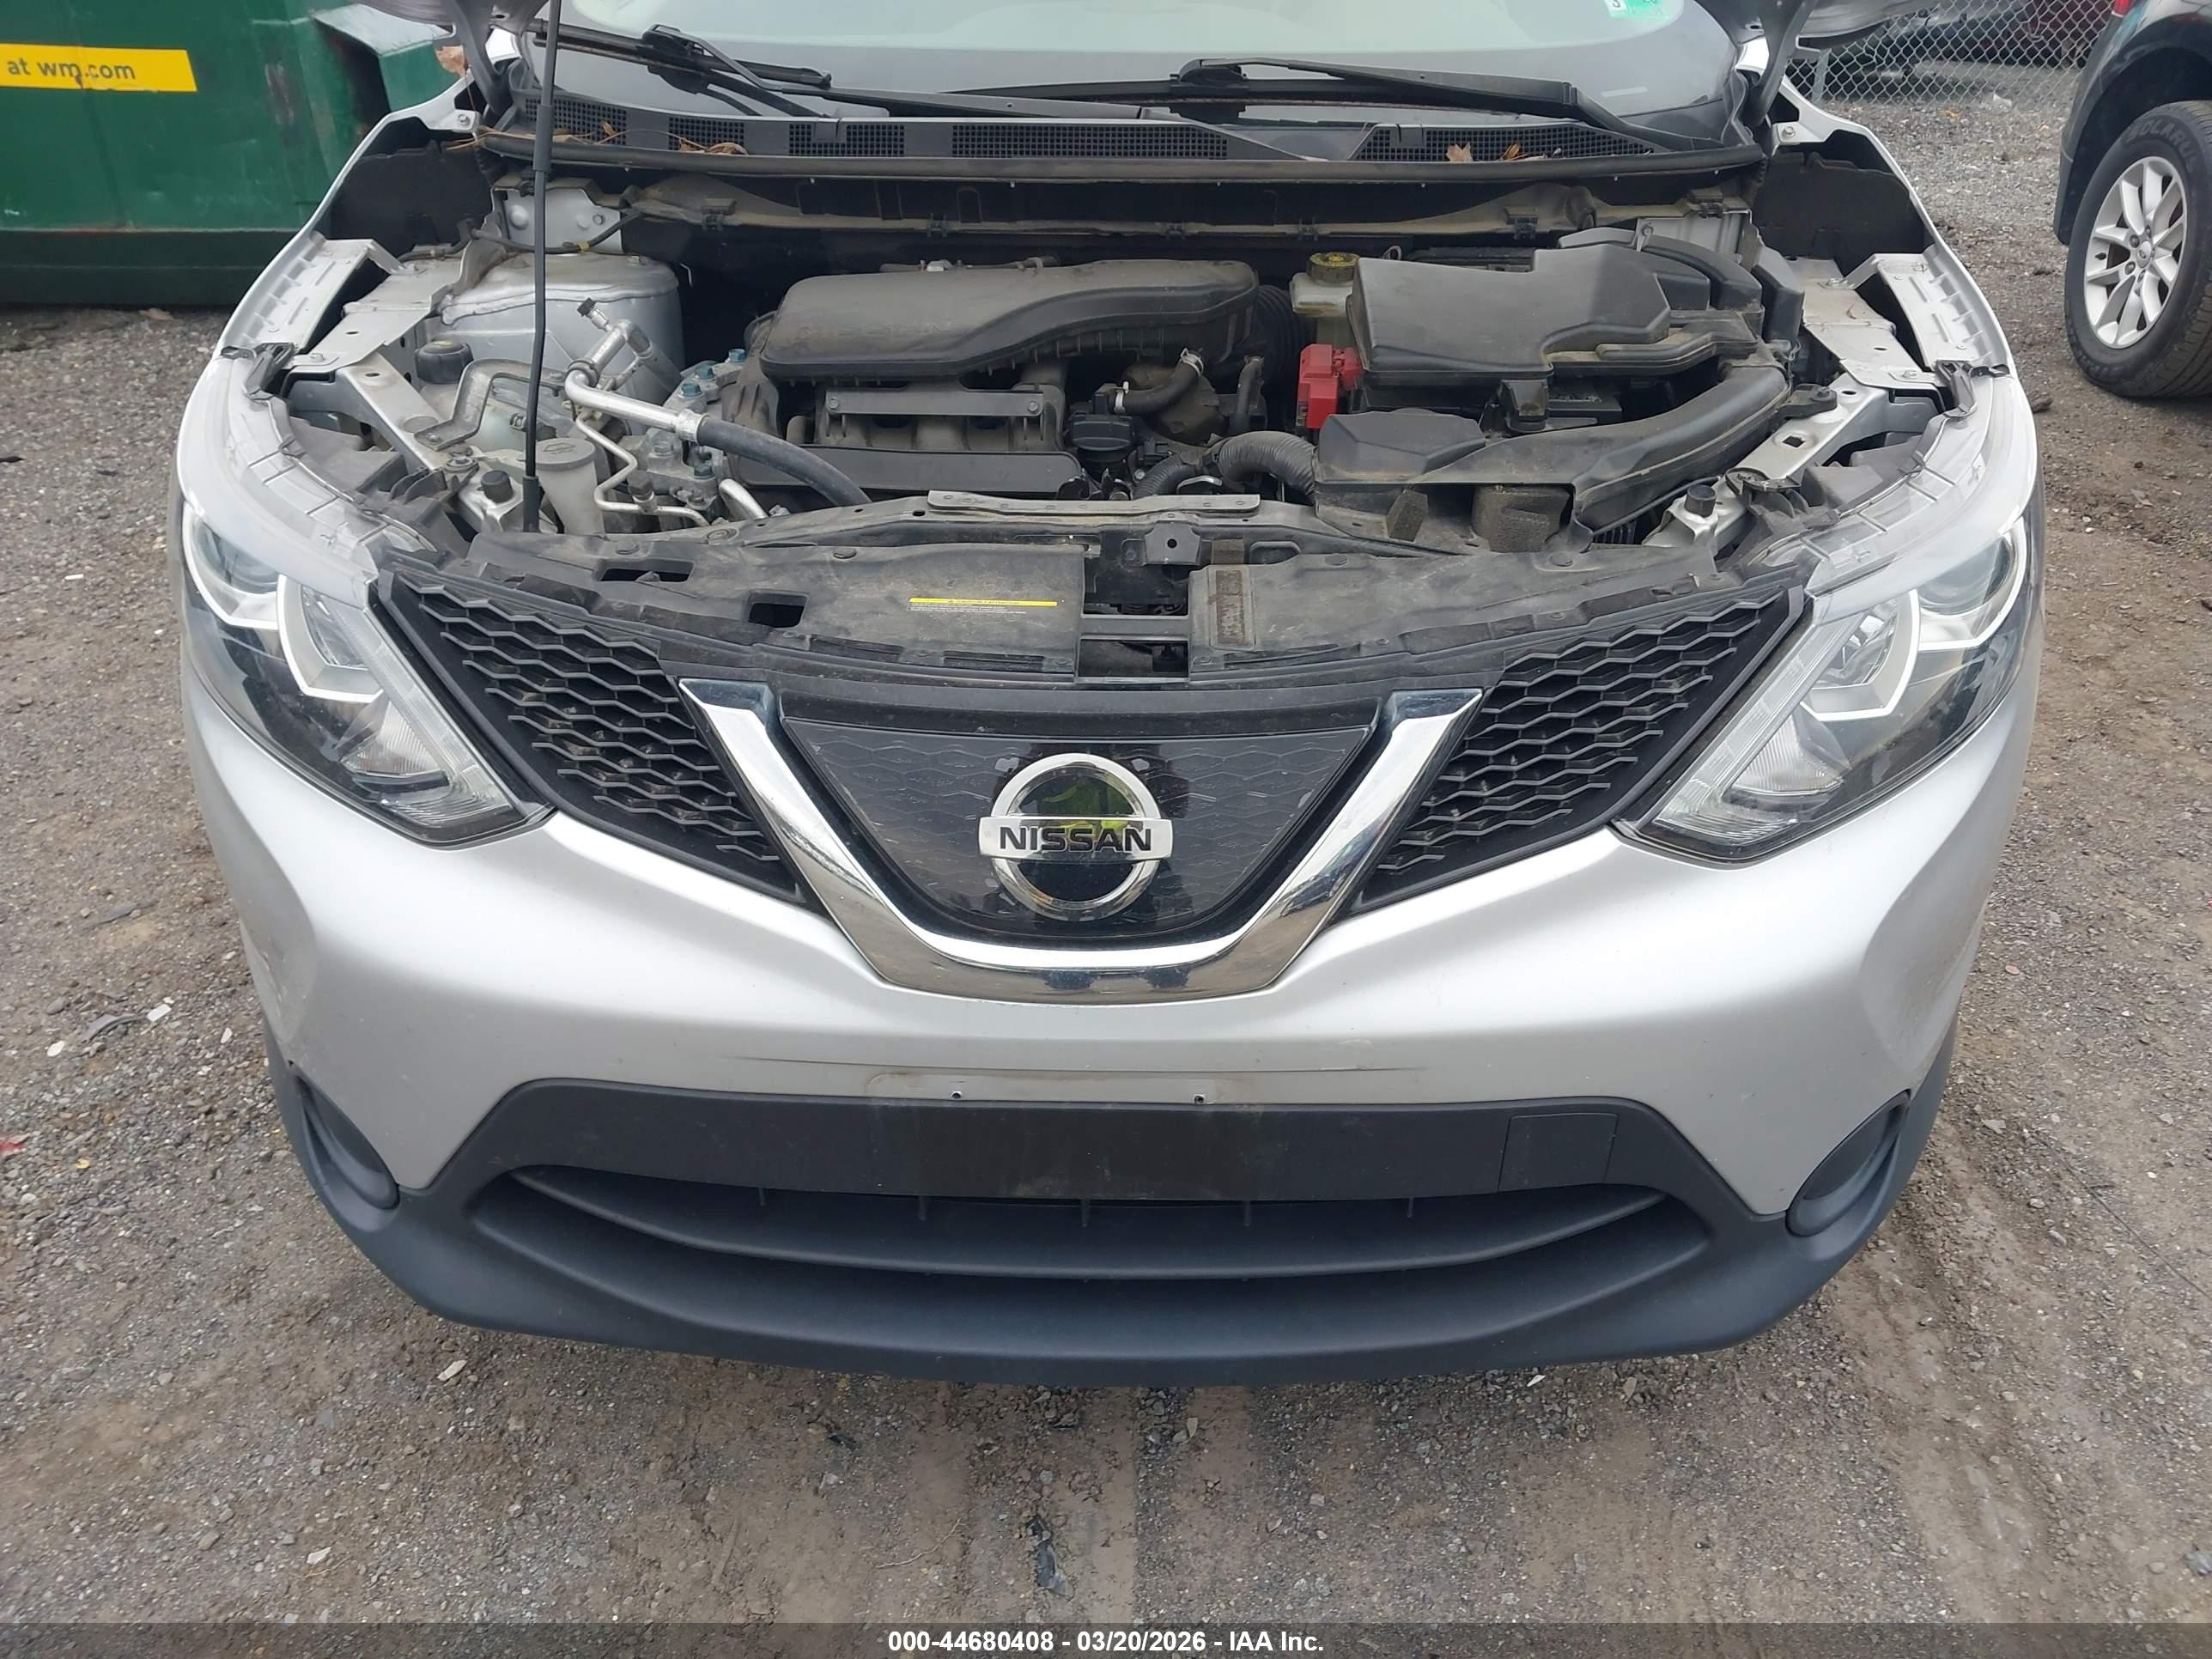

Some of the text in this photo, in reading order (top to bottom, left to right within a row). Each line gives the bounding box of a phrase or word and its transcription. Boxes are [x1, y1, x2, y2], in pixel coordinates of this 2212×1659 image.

[6, 57, 137, 80] at wm.com
[1000, 826, 1152, 852] NISSAN
